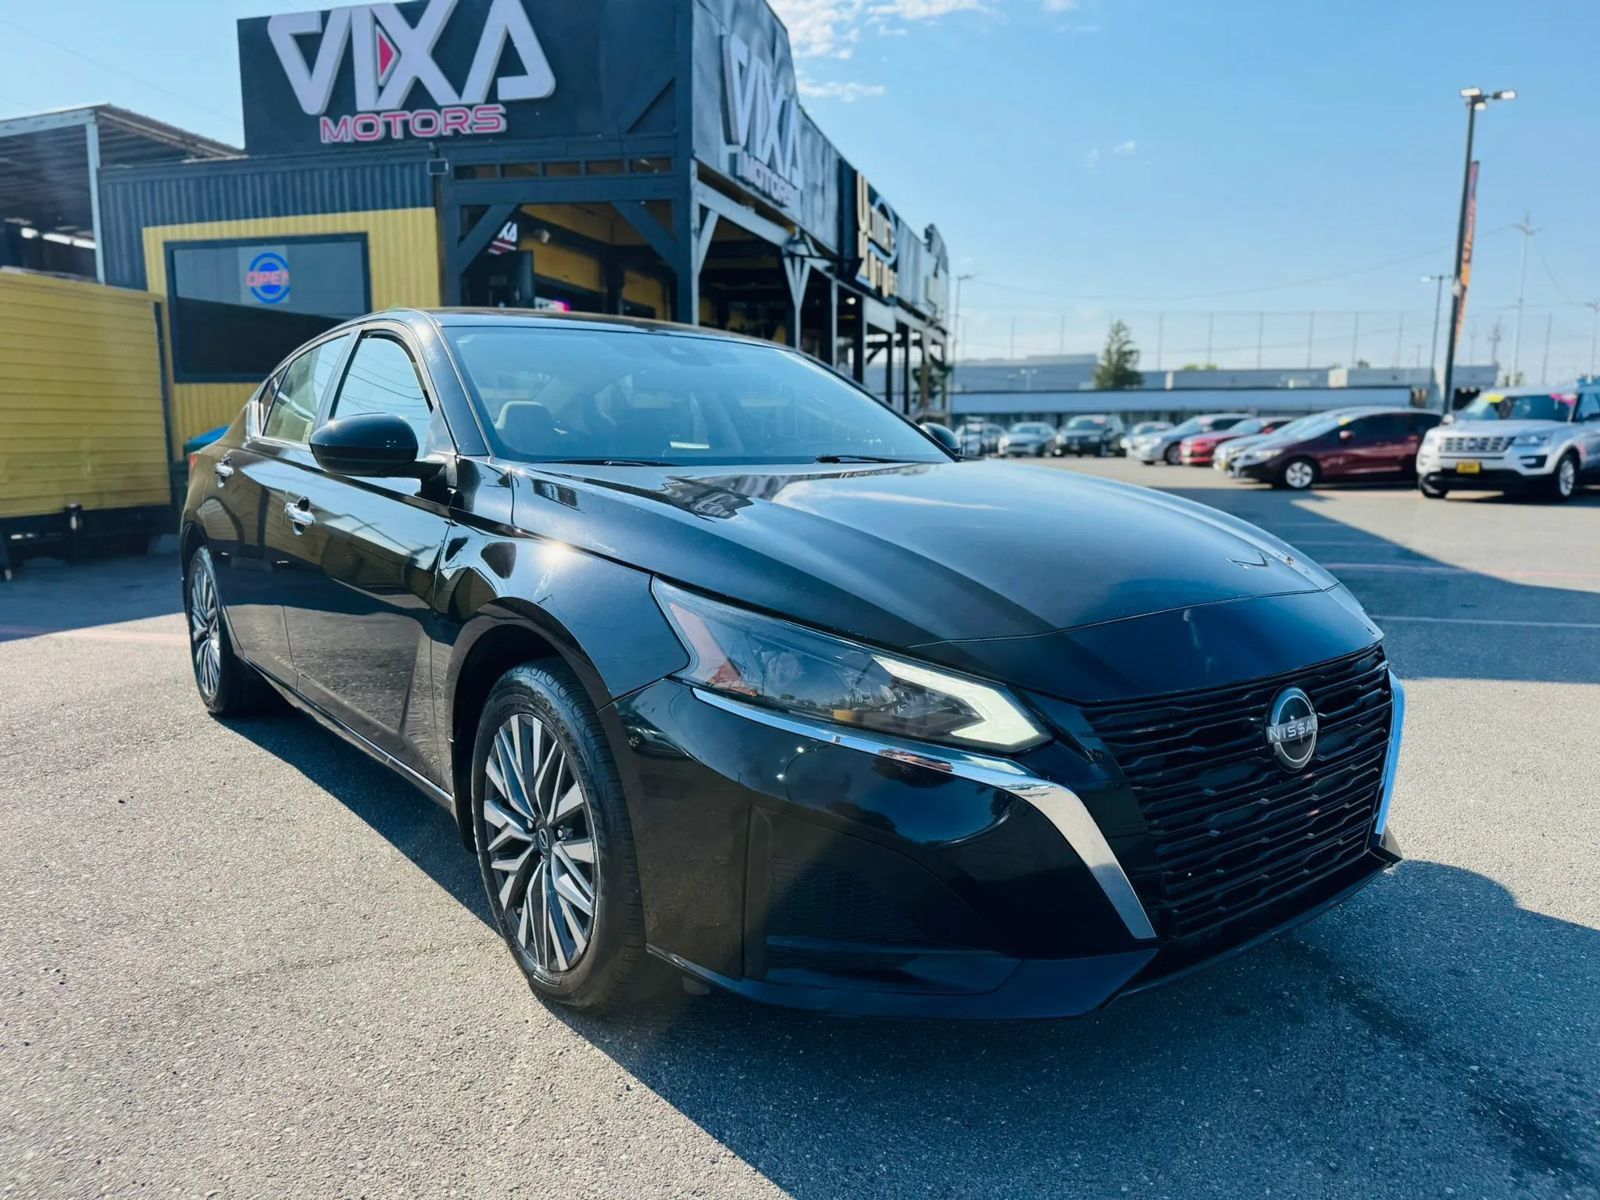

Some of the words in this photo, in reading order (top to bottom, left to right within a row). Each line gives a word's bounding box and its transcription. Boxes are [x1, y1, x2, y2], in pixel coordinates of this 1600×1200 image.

[267, 0, 556, 115] VIXA
[320, 104, 507, 143] MOTORS
[1268, 720, 1317, 741] NISSA
